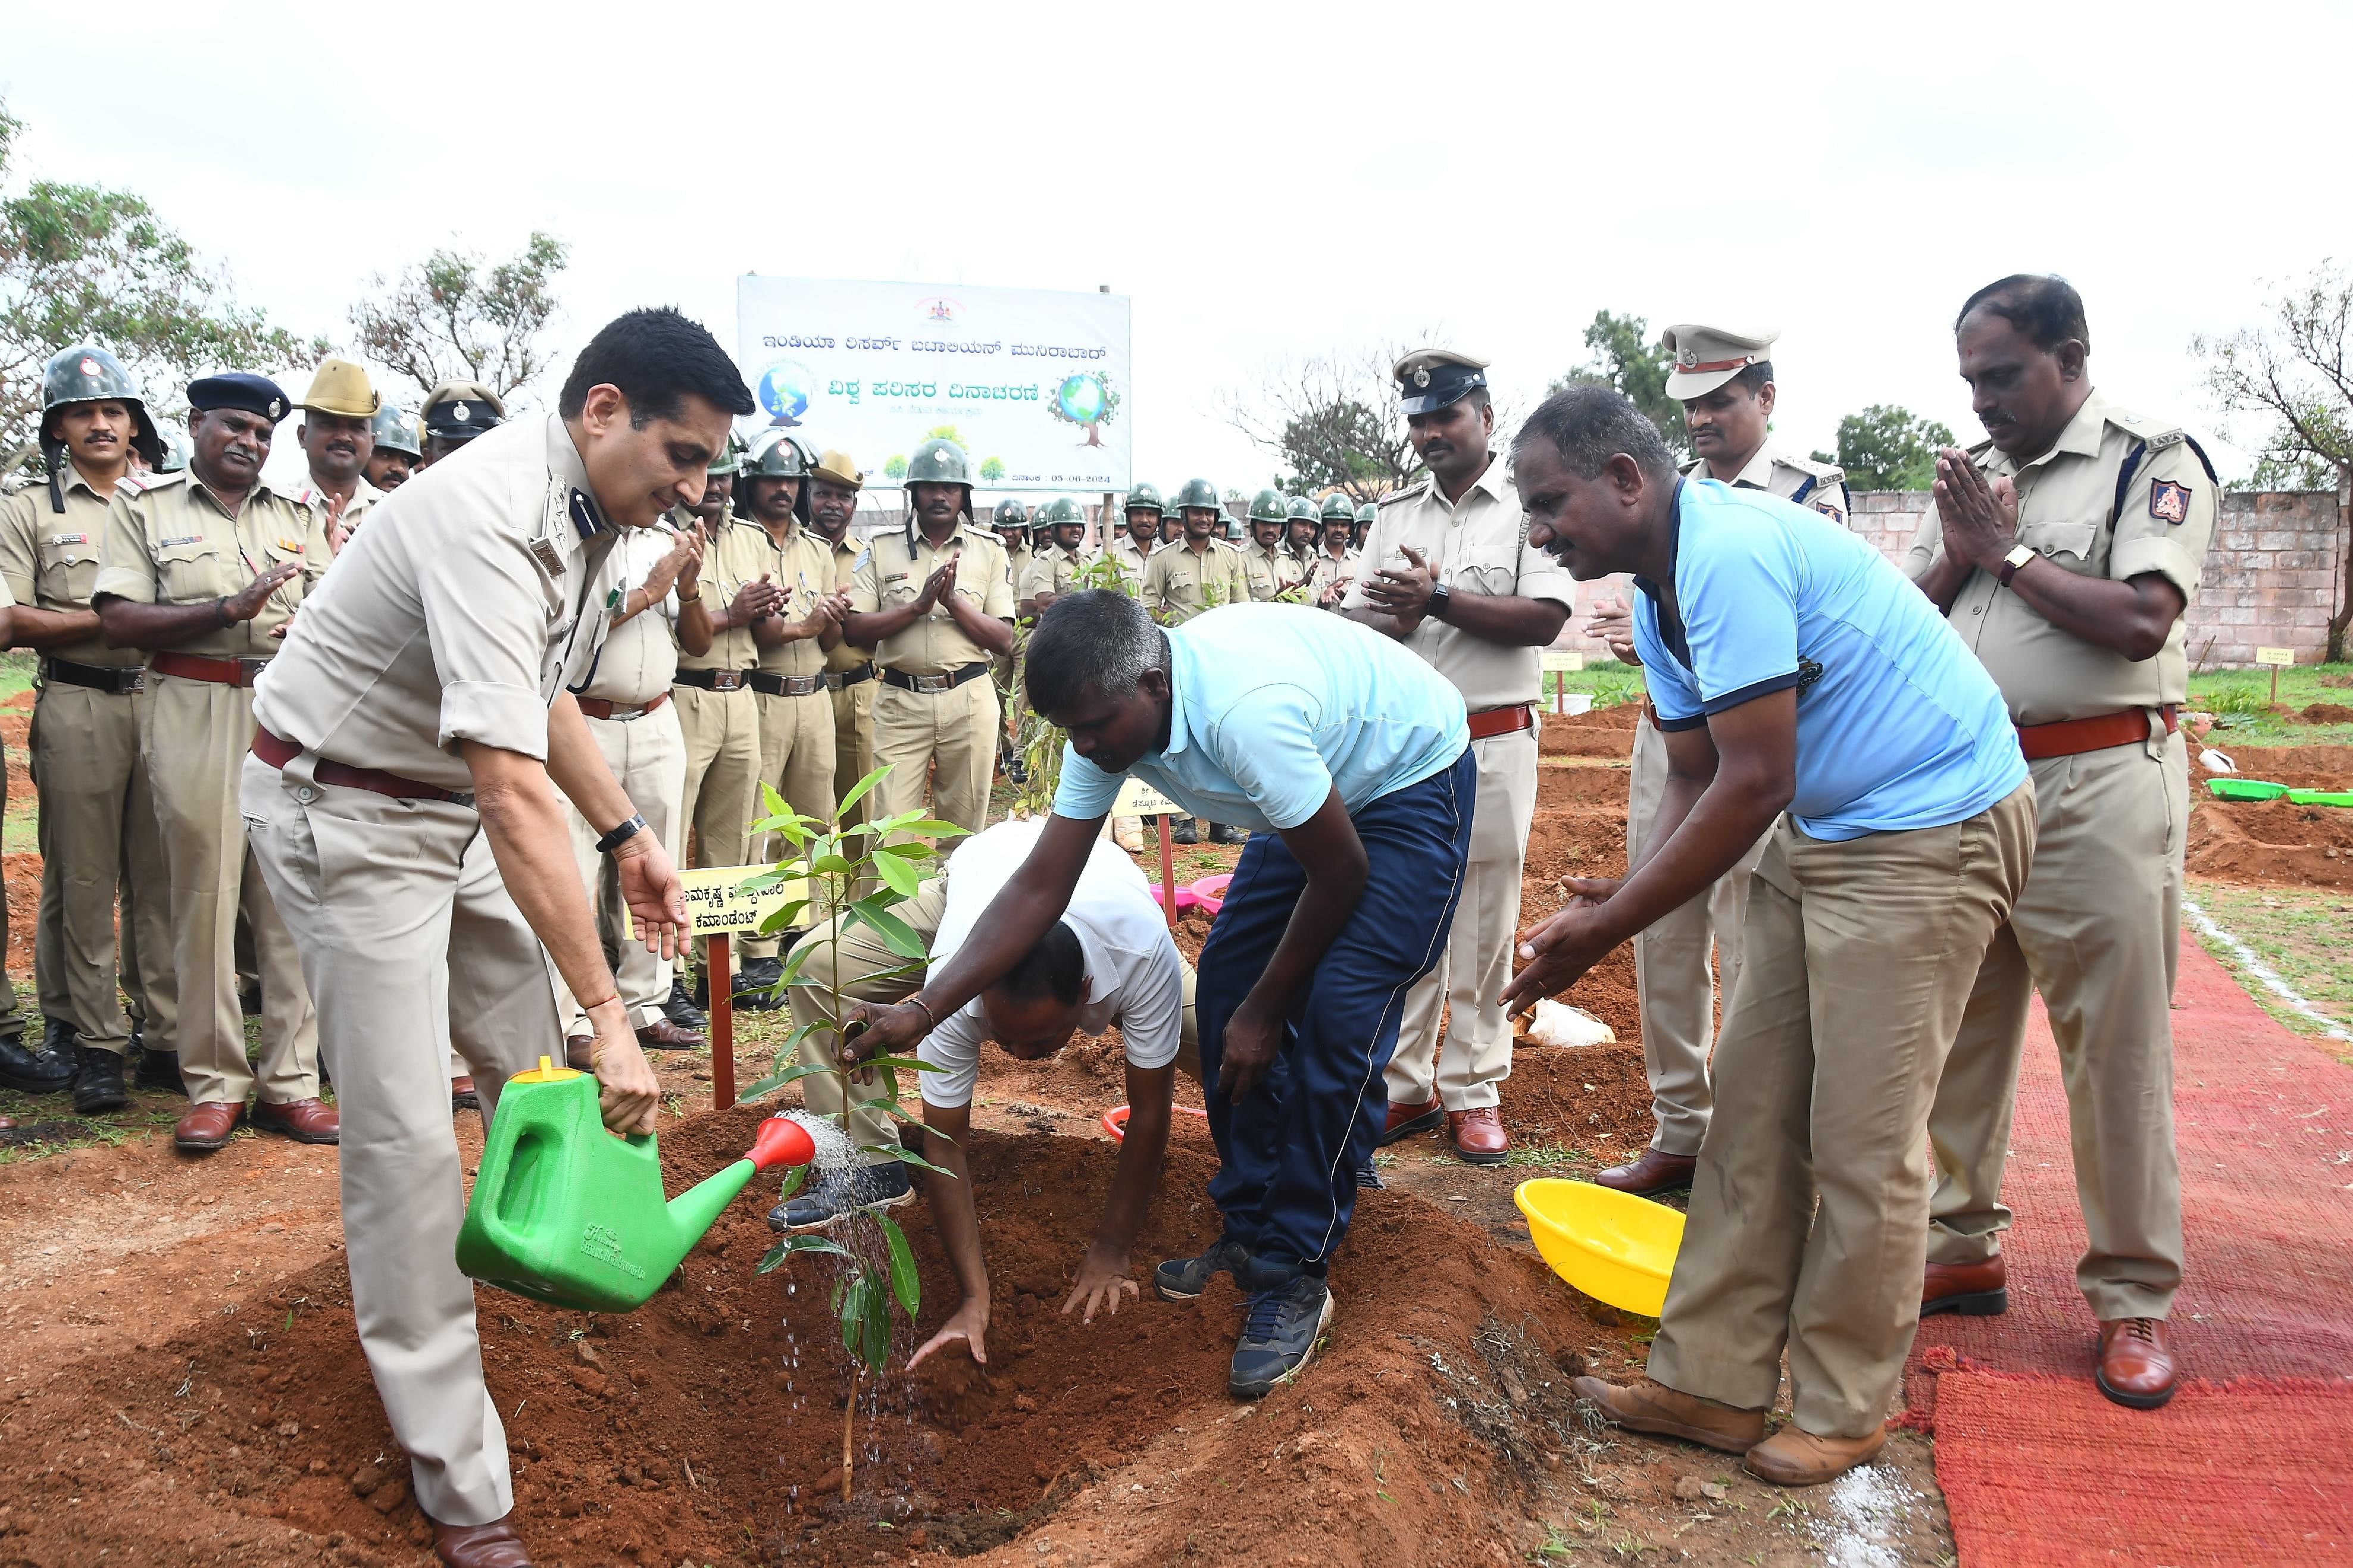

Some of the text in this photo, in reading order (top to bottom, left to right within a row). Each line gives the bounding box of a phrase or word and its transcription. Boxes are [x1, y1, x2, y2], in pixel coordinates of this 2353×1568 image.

[763, 335, 1106, 359] ಇಂಡಿಯಾ ರಿಸರ್ವ್ ಬಟಾಲಿಯನ್ ಮುನಿರಾಬಾದ್
[829, 379, 1039, 405] ವಿಶ್ವ ಪರಿಸರ ದಿನಾಚರಣೆ
[696, 909, 758, 928] ಕಮಾಂಡೆಂಟ್
